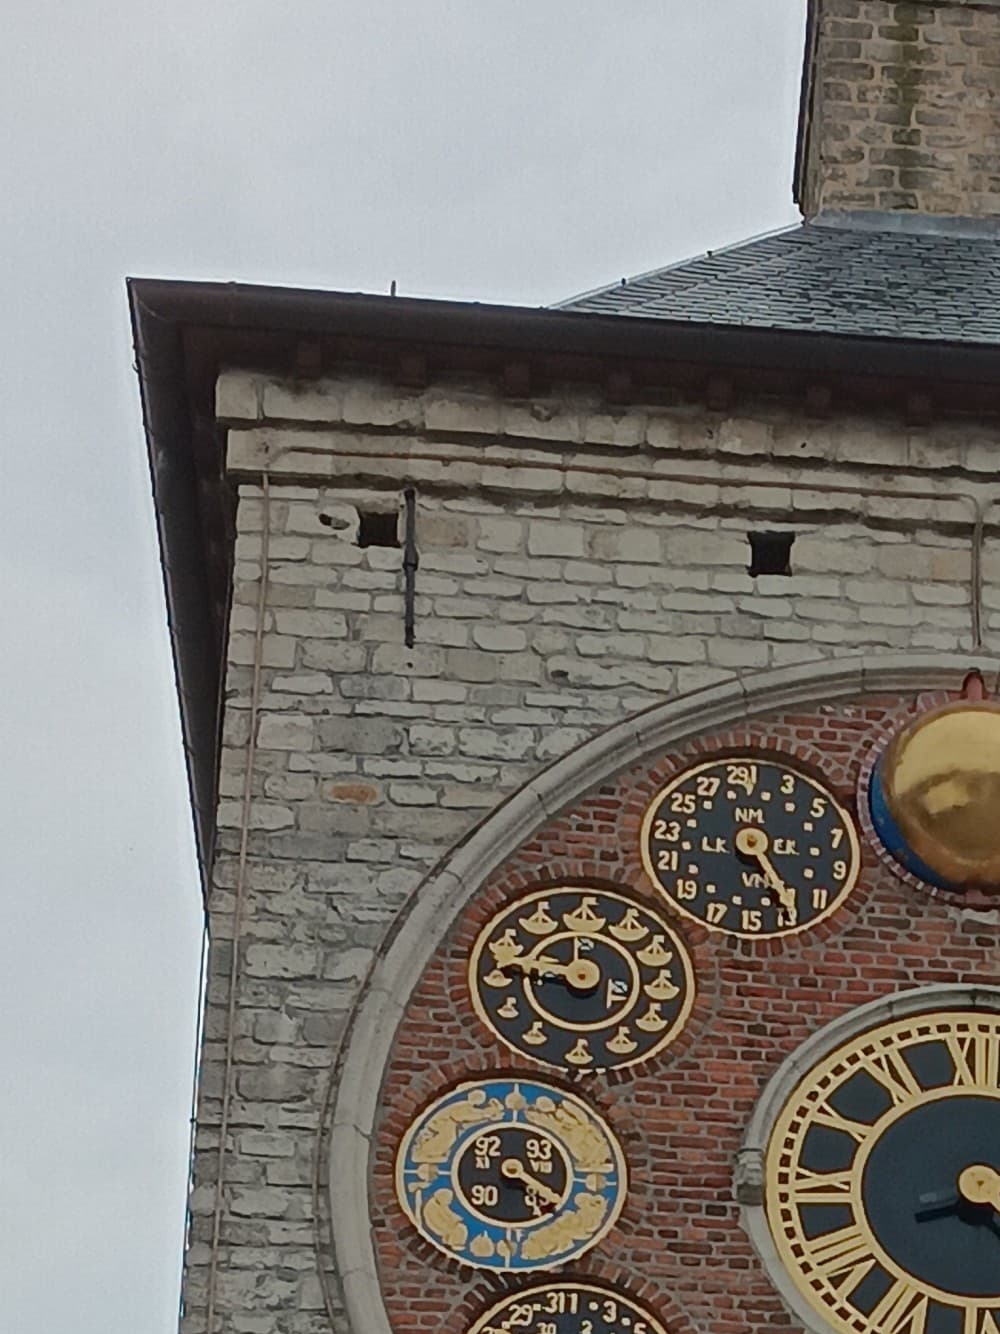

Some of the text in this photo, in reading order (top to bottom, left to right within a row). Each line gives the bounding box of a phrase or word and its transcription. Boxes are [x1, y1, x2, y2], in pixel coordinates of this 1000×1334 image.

[697, 777, 720, 796] 27
[781, 775, 795, 794] 3
[671, 793, 696, 813] 25
[810, 798, 827, 818] 5
[735, 808, 764, 824] NM
[655, 820, 680, 841] 23
[831, 829, 843, 848] 7
[702, 837, 729, 853] LK
[774, 839, 799, 855] EK
[658, 851, 678, 871] 21
[833, 861, 846, 880] 9
[677, 880, 696, 899] 19
[813, 889, 827, 908] 11
[707, 904, 727, 923] 17
[742, 911, 762, 931] 15
[945, 1034, 1000, 1089] XII
[860, 1047, 923, 1106] XI
[811, 1102, 873, 1142] X
[475, 1135, 500, 1156] 92
[526, 1139, 551, 1159] 93
[476, 1158, 490, 1169] XI
[795, 1167, 852, 1203] IX
[472, 1185, 498, 1206] 90
[804, 1223, 876, 1299] VIII
[509, 1305, 533, 1326] 29
[603, 1301, 616, 1322] 3
[580, 1321, 592, 1334] 2
